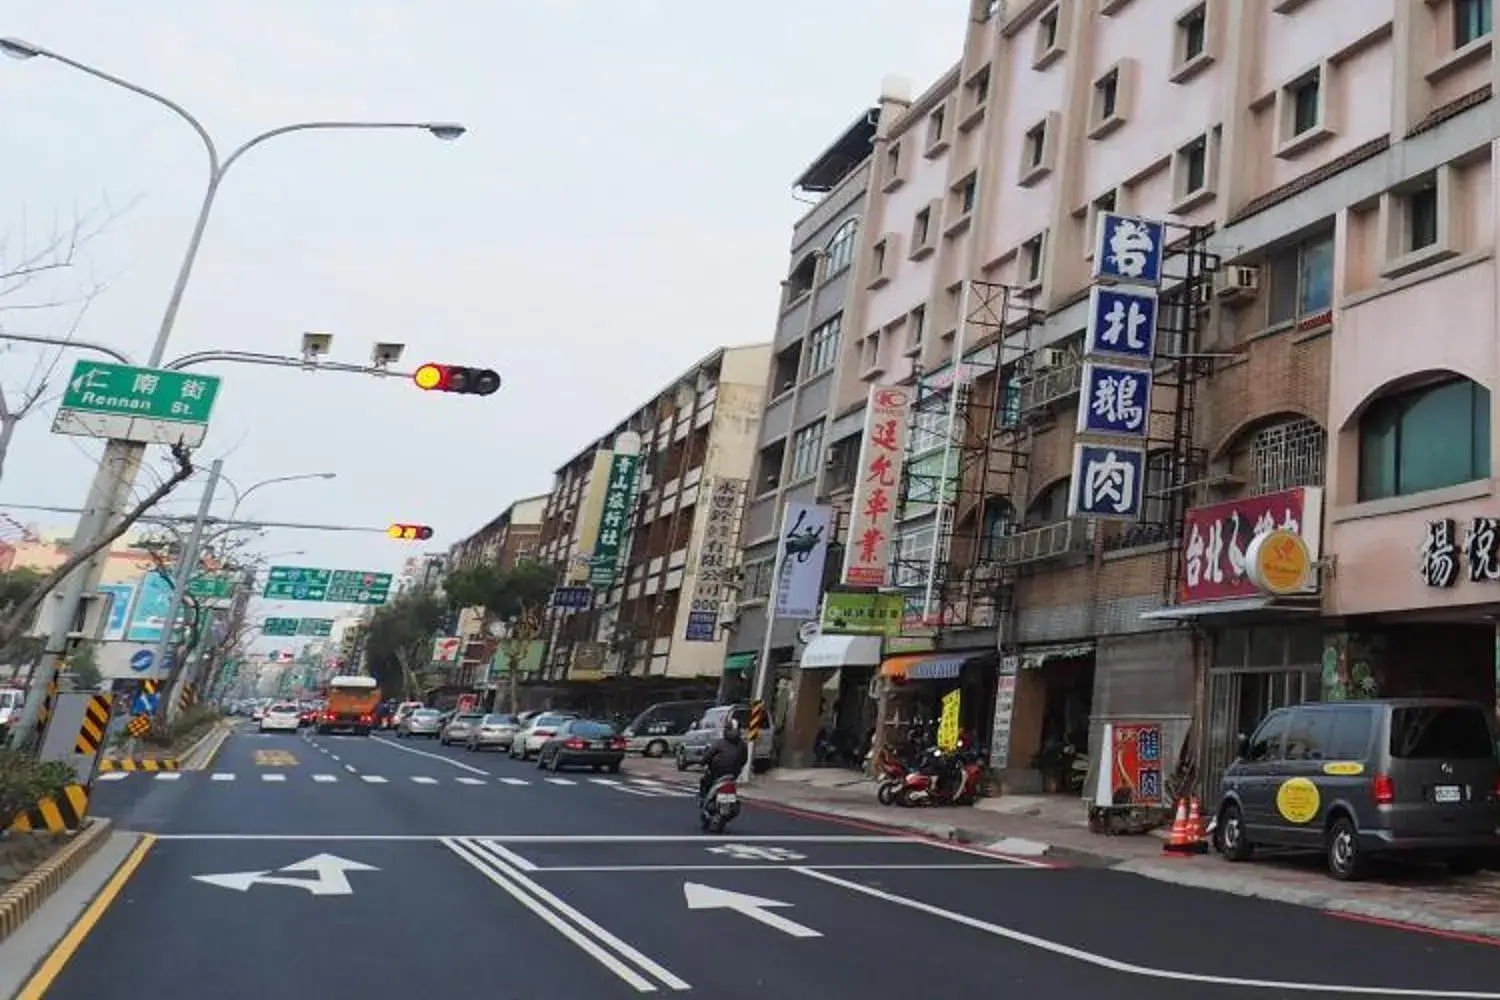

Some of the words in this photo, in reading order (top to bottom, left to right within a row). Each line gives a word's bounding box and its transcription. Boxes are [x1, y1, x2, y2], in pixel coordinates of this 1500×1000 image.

[85, 367, 207, 400] 仁南街
[81, 391, 152, 409] Rennan
[171, 401, 194, 415] St.
